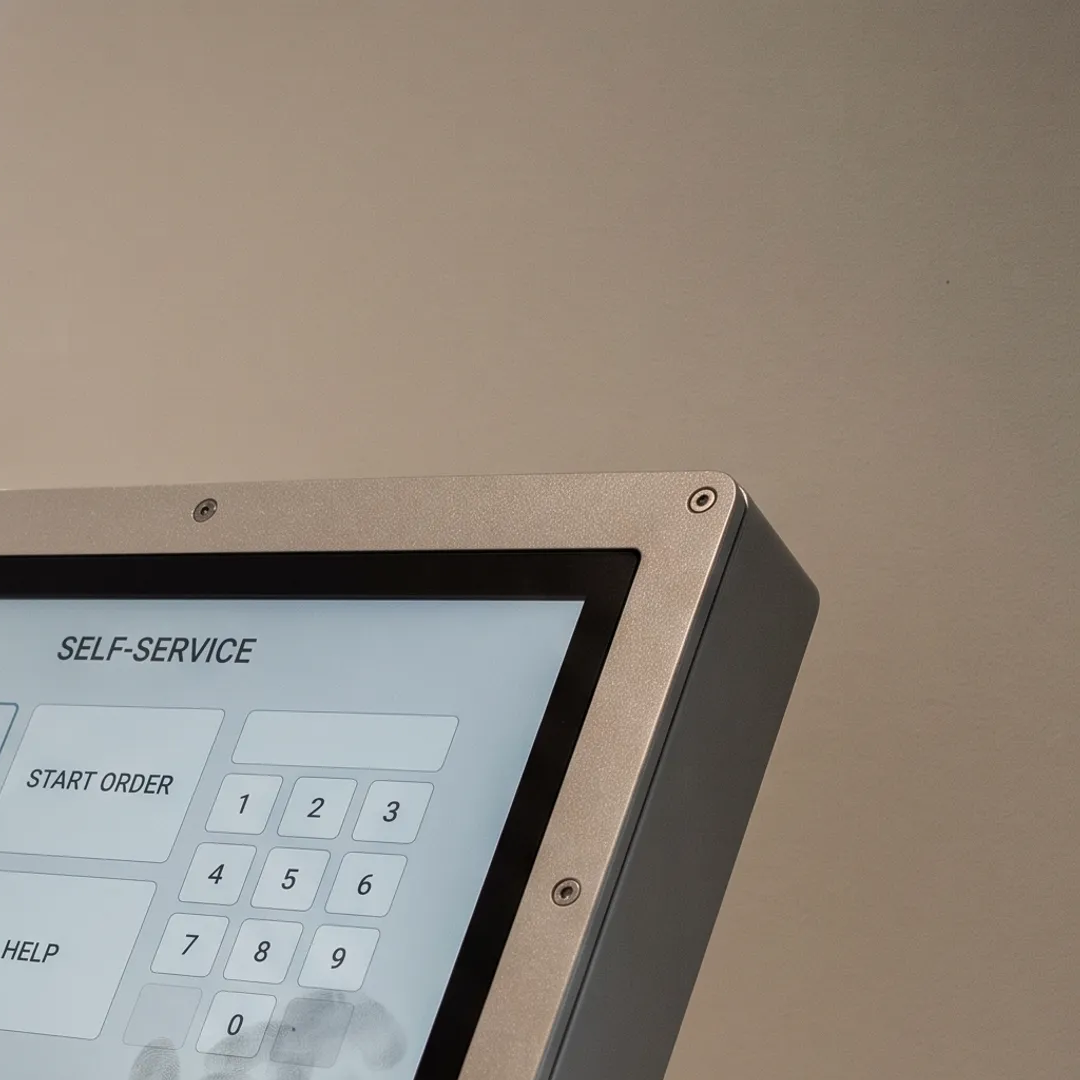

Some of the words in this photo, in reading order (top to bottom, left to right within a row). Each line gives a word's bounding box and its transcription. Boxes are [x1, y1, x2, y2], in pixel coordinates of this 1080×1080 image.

[58, 636, 257, 663] SELF-SERVICE
[27, 769, 97, 790] START
[101, 773, 173, 794] ORDER
[240, 794, 249, 814] 1
[307, 798, 324, 817] 2
[383, 801, 400, 822] 3
[208, 864, 224, 884] 4
[282, 869, 299, 889] 5
[358, 874, 373, 895] 6
[1, 940, 59, 962] HELP
[182, 935, 199, 955] 7
[254, 941, 270, 962] 8
[331, 948, 346, 969] 9
[228, 1014, 243, 1035] 0
